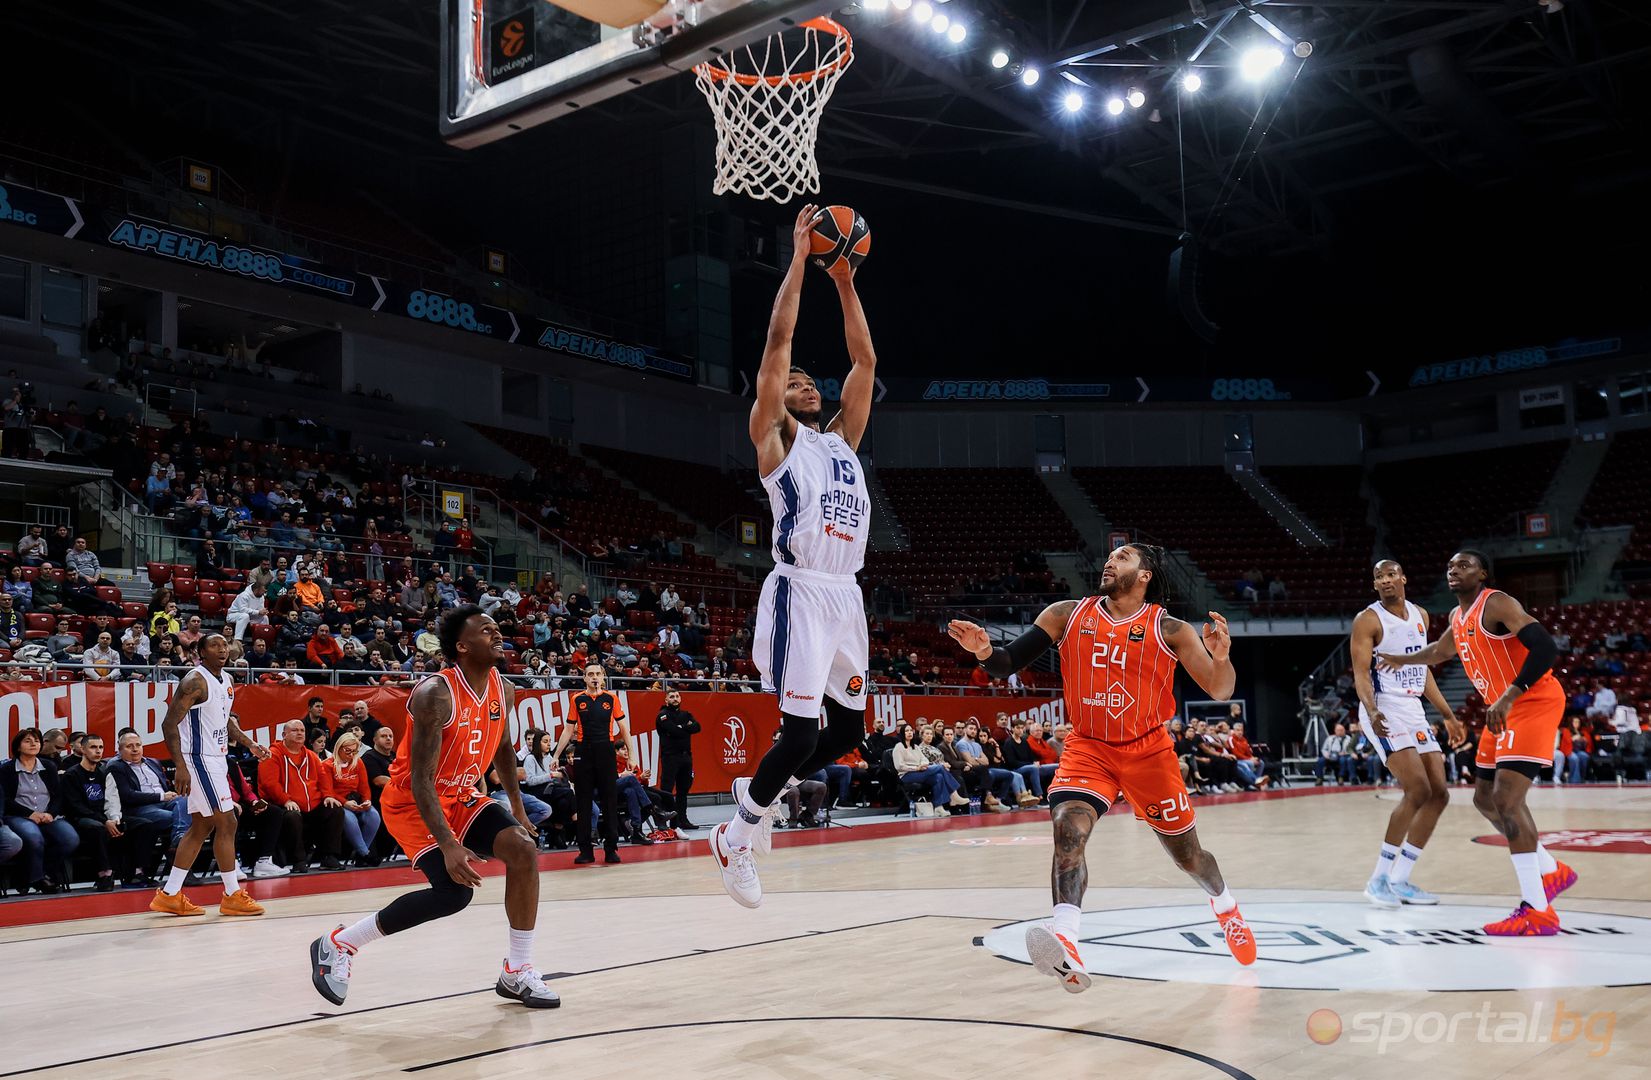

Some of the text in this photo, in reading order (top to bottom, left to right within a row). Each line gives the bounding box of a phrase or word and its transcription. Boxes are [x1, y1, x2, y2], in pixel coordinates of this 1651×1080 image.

[111, 222, 219, 266] АРЕНА
[222, 247, 283, 280] 8888
[407, 290, 493, 334] 8888.BG
[541, 329, 607, 358] АРЕНА
[1411, 356, 1493, 385] АРЕНА
[926, 383, 1000, 398] АРЕНА
[1004, 382, 1049, 398] 8888
[447, 500, 459, 510] 102
[1091, 642, 1127, 670] 24
[1460, 641, 1476, 662] 21
[1107, 693, 1125, 708] IBI
[469, 729, 482, 755] 2
[1161, 792, 1191, 822] 24
